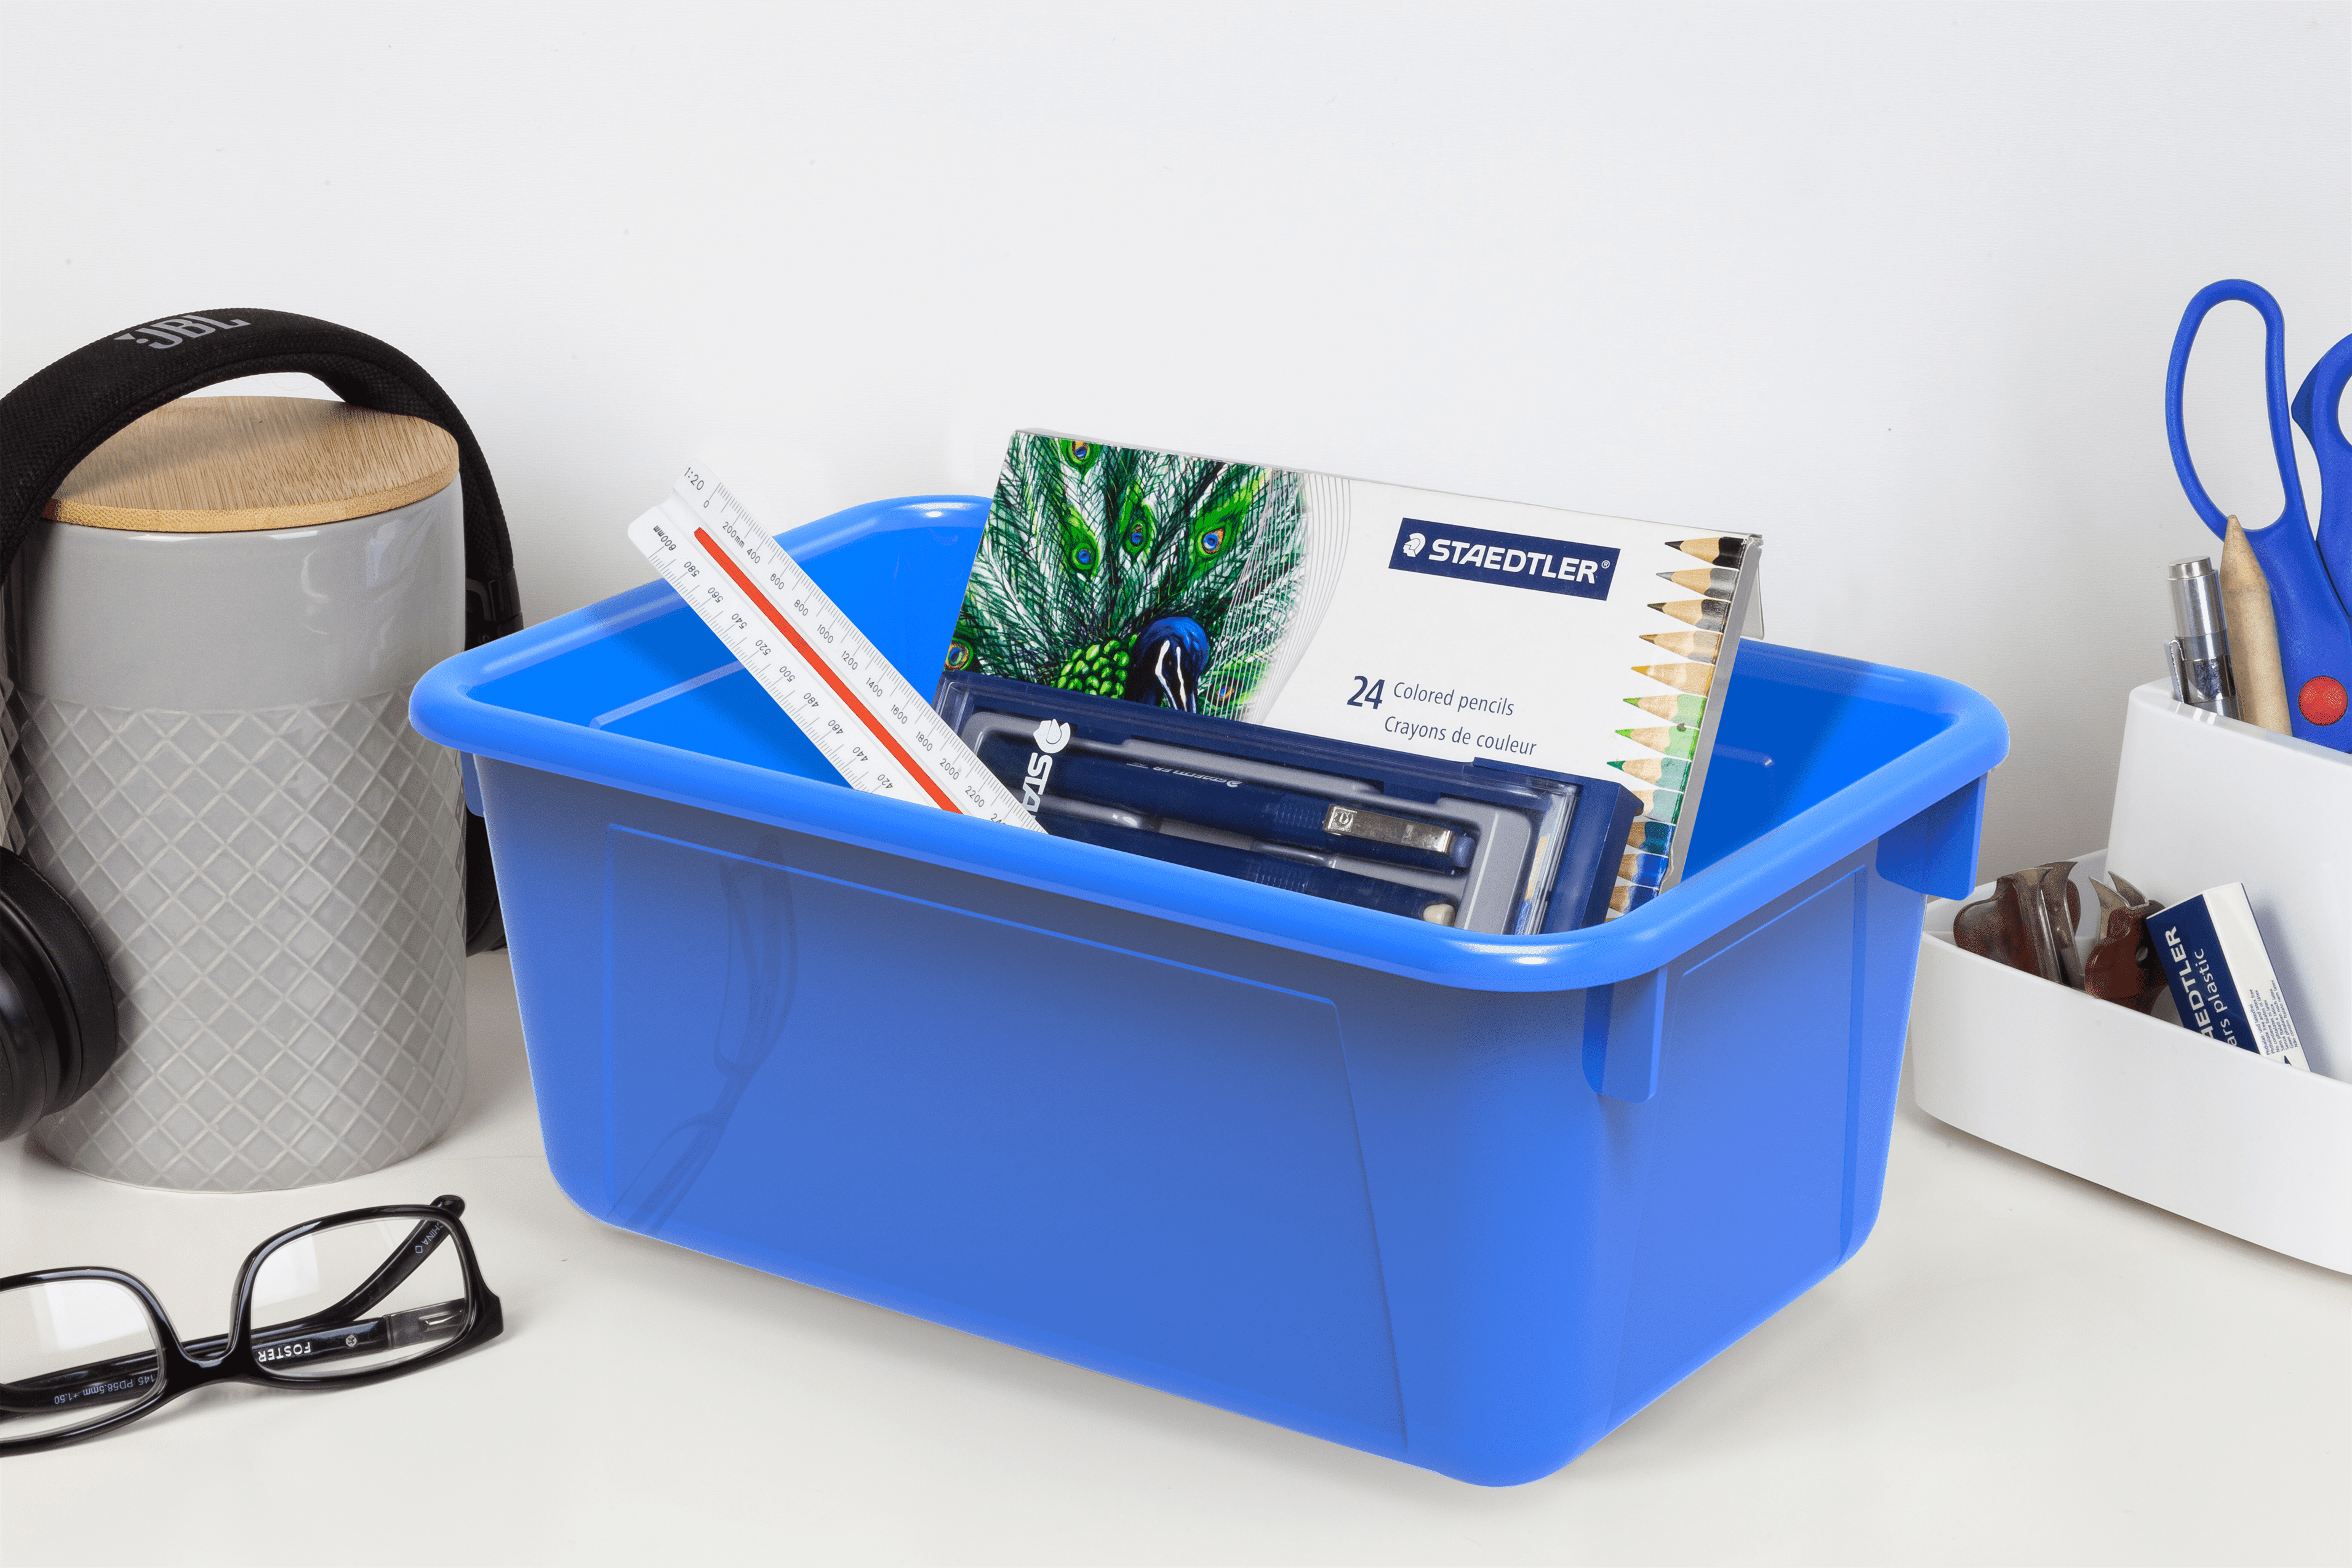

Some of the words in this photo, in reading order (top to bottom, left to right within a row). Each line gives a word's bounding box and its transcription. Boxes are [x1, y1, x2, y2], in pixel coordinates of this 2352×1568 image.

[684, 467, 705, 490] 1:20
[653, 525, 676, 551] 600mm
[684, 561, 700, 577] 580
[708, 587, 724, 603] 560
[731, 613, 747, 630] 540
[703, 500, 710, 508] 0
[722, 521, 745, 548] 200mm
[746, 548, 761, 564] 400
[770, 573, 785, 590] 600
[794, 599, 809, 616] 800
[817, 624, 834, 644] 1000
[841, 650, 858, 670] 1200
[866, 678, 883, 697] 1400
[890, 704, 908, 724] 1600
[915, 731, 933, 751] 1800
[940, 758, 959, 780] 2000
[965, 785, 985, 807] 2200
[755, 639, 771, 656] 520
[779, 666, 795, 682] 500
[803, 692, 819, 708] 480
[1346, 675, 1385, 710] 24
[1393, 682, 1455, 706] Colored
[1457, 697, 1514, 716] pencils
[828, 719, 844, 735] 460
[1384, 716, 1447, 740] Crayons
[1452, 726, 1471, 745] de
[1476, 734, 1537, 756] couleur
[852, 746, 868, 762] 440
[877, 774, 894, 790] 420
[2194, 948, 2228, 1013] plastic
[2265, 1031, 2275, 1054] Phthalate
[2268, 1025, 2277, 1044] contiene
[258, 1342, 311, 1362] FOSTER
[138, 1374, 155, 1385] 145
[54, 1393, 78, 1404] +1.50
